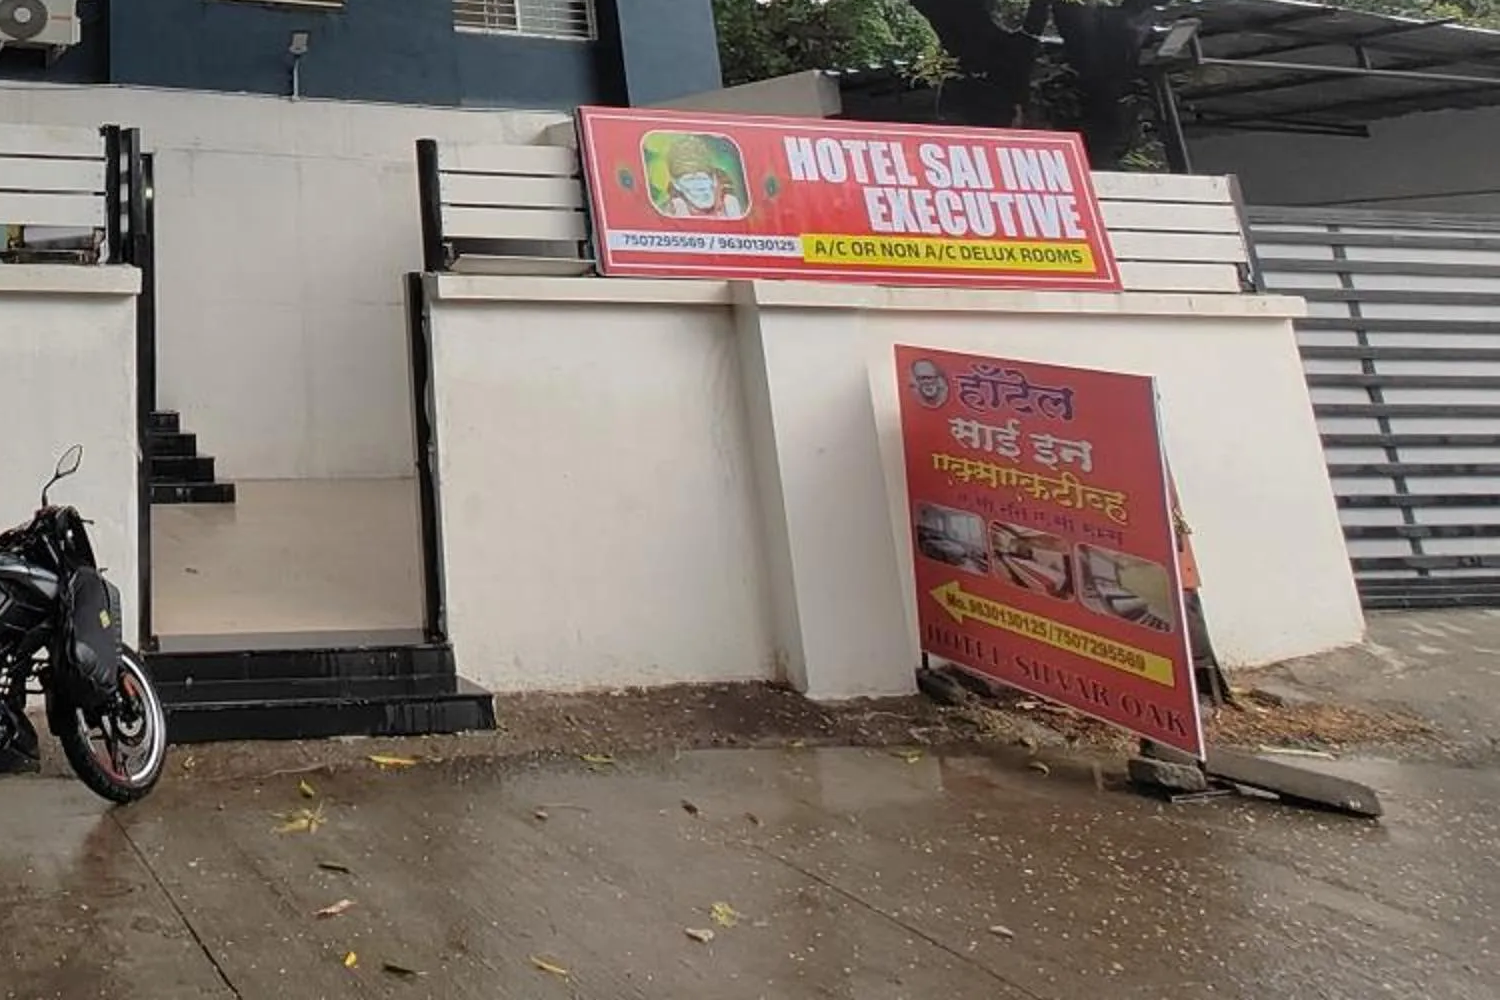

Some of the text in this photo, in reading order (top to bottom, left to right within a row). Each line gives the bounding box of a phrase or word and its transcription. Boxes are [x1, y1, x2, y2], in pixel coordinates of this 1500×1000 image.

[783, 135, 1074, 193] HOTEL SAI INN
[863, 186, 1087, 240] EXECUTIVE
[719, 237, 795, 251] 9630130125
[814, 239, 1083, 264] A/C OR NON A/C DELUX ROOMS
[955, 362, 1075, 421] हॉटेल
[948, 417, 1093, 473] साई इन
[1121, 693, 1188, 737] OAK
